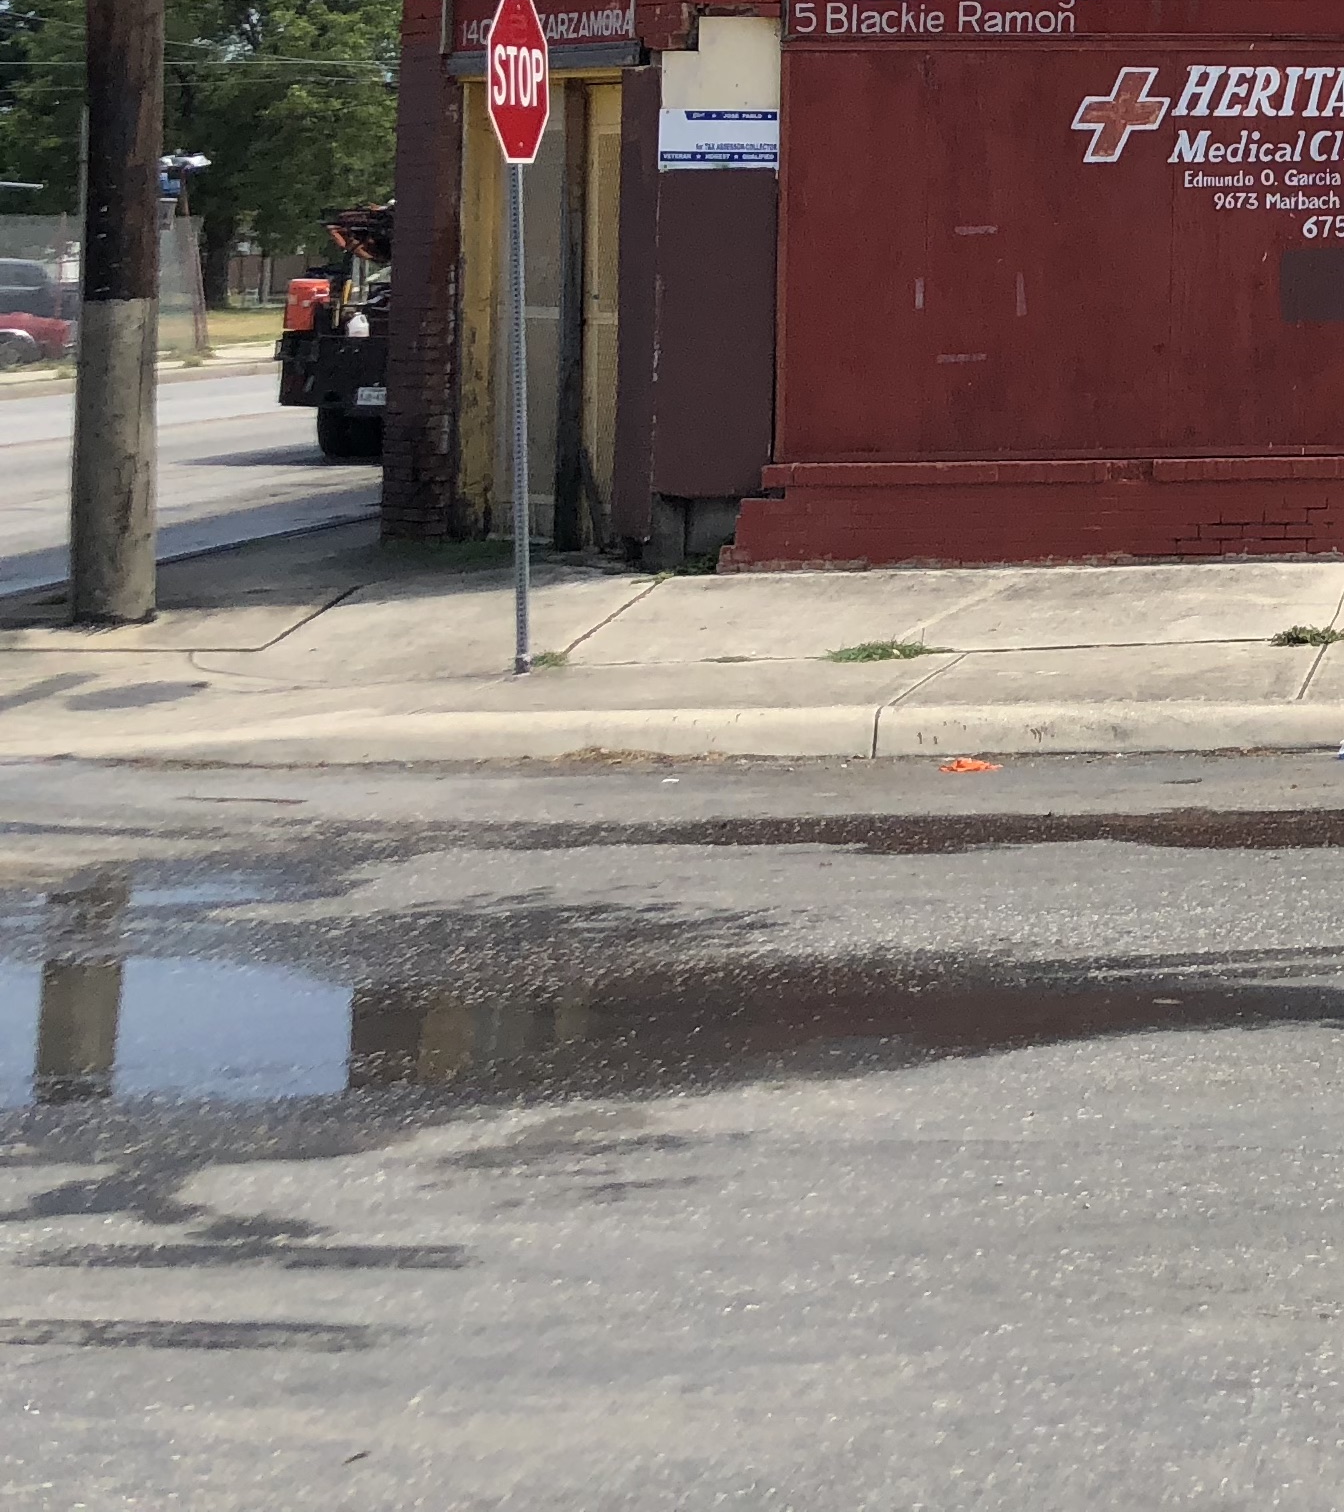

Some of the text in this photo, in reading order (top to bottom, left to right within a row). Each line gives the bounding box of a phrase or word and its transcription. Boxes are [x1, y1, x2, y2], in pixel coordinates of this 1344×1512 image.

[795, 3, 1075, 35] 5 Blackie Ramon
[493, 43, 544, 108] STOP
[1167, 129, 1306, 164] Medical
[1184, 170, 1254, 188] Edmundo
[1260, 169, 1279, 186] O.
[1213, 192, 1259, 210] 9673
[1265, 190, 1340, 210] Marbach
